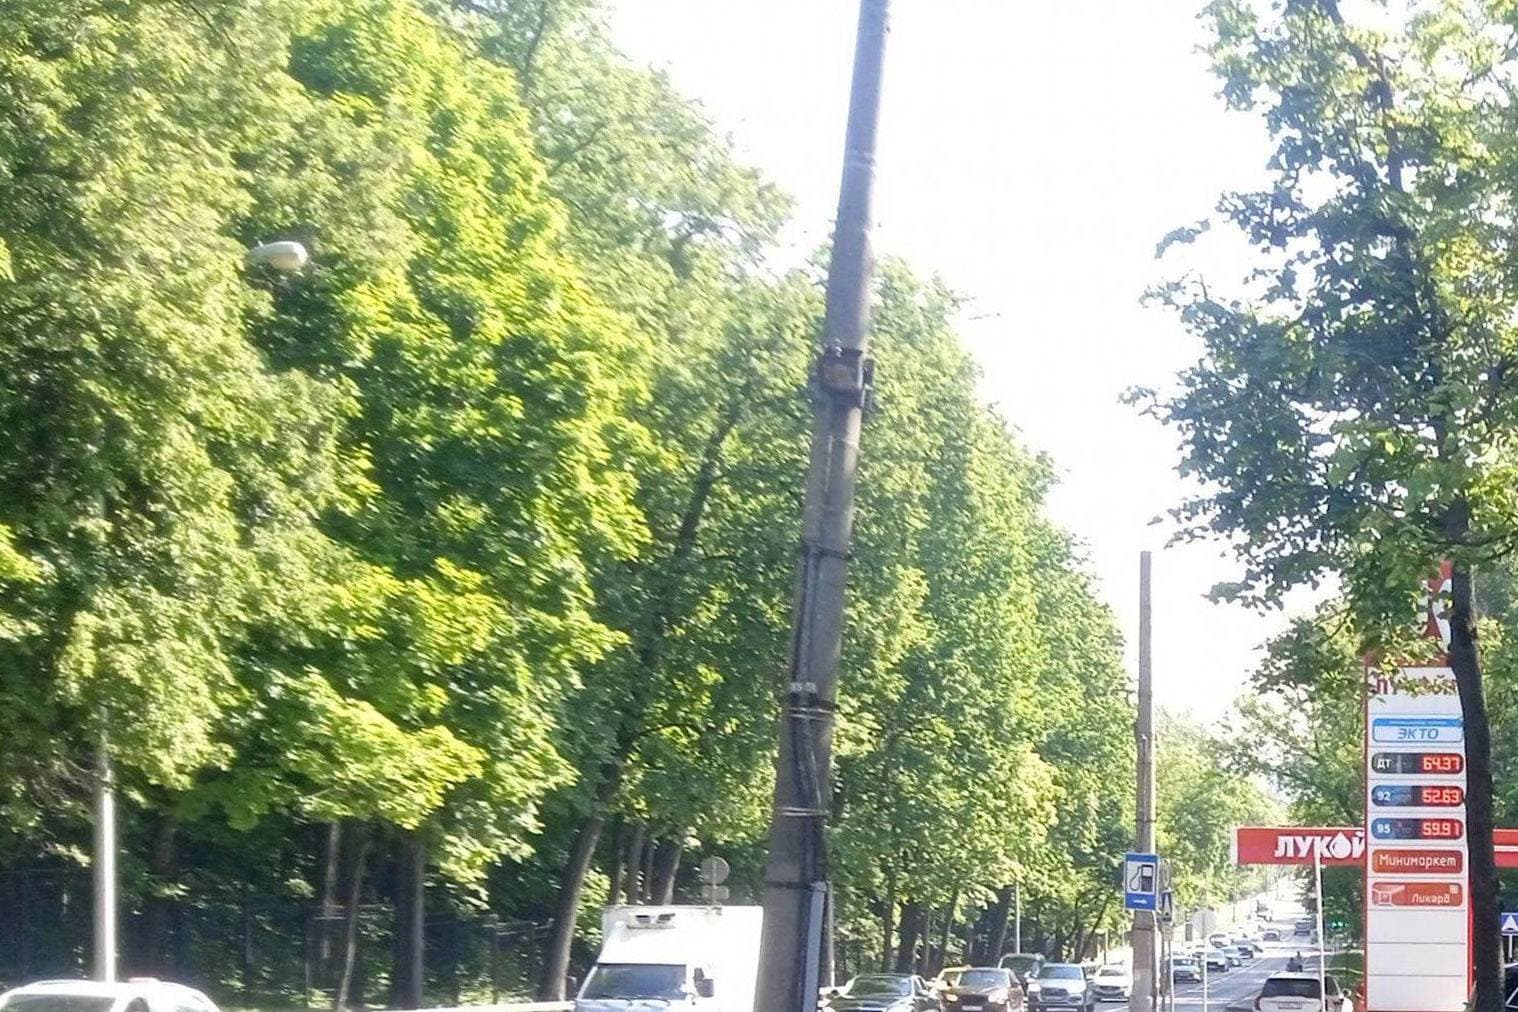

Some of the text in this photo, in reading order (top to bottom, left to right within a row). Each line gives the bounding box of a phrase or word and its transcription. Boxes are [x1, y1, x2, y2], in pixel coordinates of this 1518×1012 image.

[1397, 728, 1439, 739] ЭКТО
[1377, 759, 1392, 769] ДТ
[1377, 791, 1391, 801] 92
[1377, 823, 1391, 833] 95
[1379, 854, 1457, 869] Минимаркет
[1411, 893, 1450, 904] Ликард
